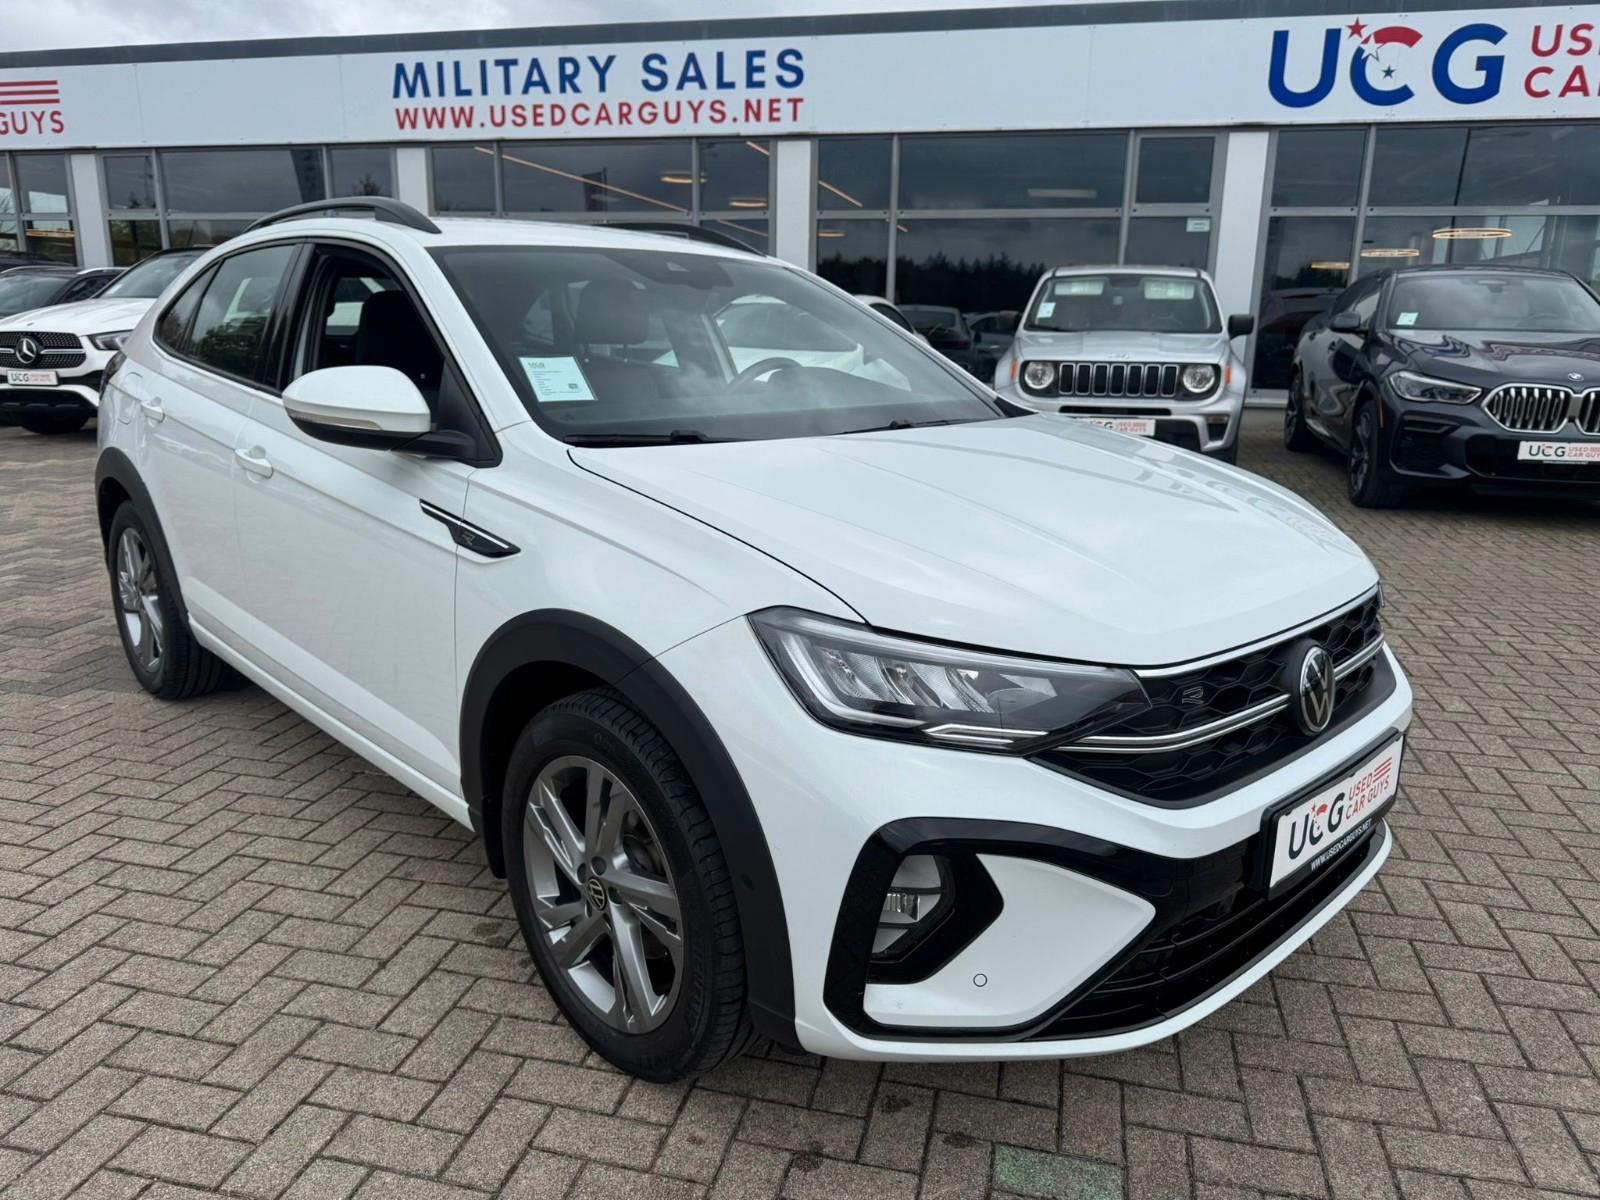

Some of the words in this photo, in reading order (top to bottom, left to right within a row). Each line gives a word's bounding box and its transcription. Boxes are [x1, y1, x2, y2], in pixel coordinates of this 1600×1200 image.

[1531, 23, 1600, 57] US
[393, 54, 616, 98] MILITARY
[641, 48, 804, 92] SALES
[1268, 20, 1508, 108] UCG
[1524, 65, 1600, 98] CA
[395, 98, 804, 130] WWW.USEDCARGUYS.NET
[1528, 445, 1566, 458] UCG
[1346, 794, 1366, 820] CAR
[1367, 774, 1389, 803] GUYS
[1349, 772, 1372, 801] USED
[1288, 792, 1346, 860] UCG
